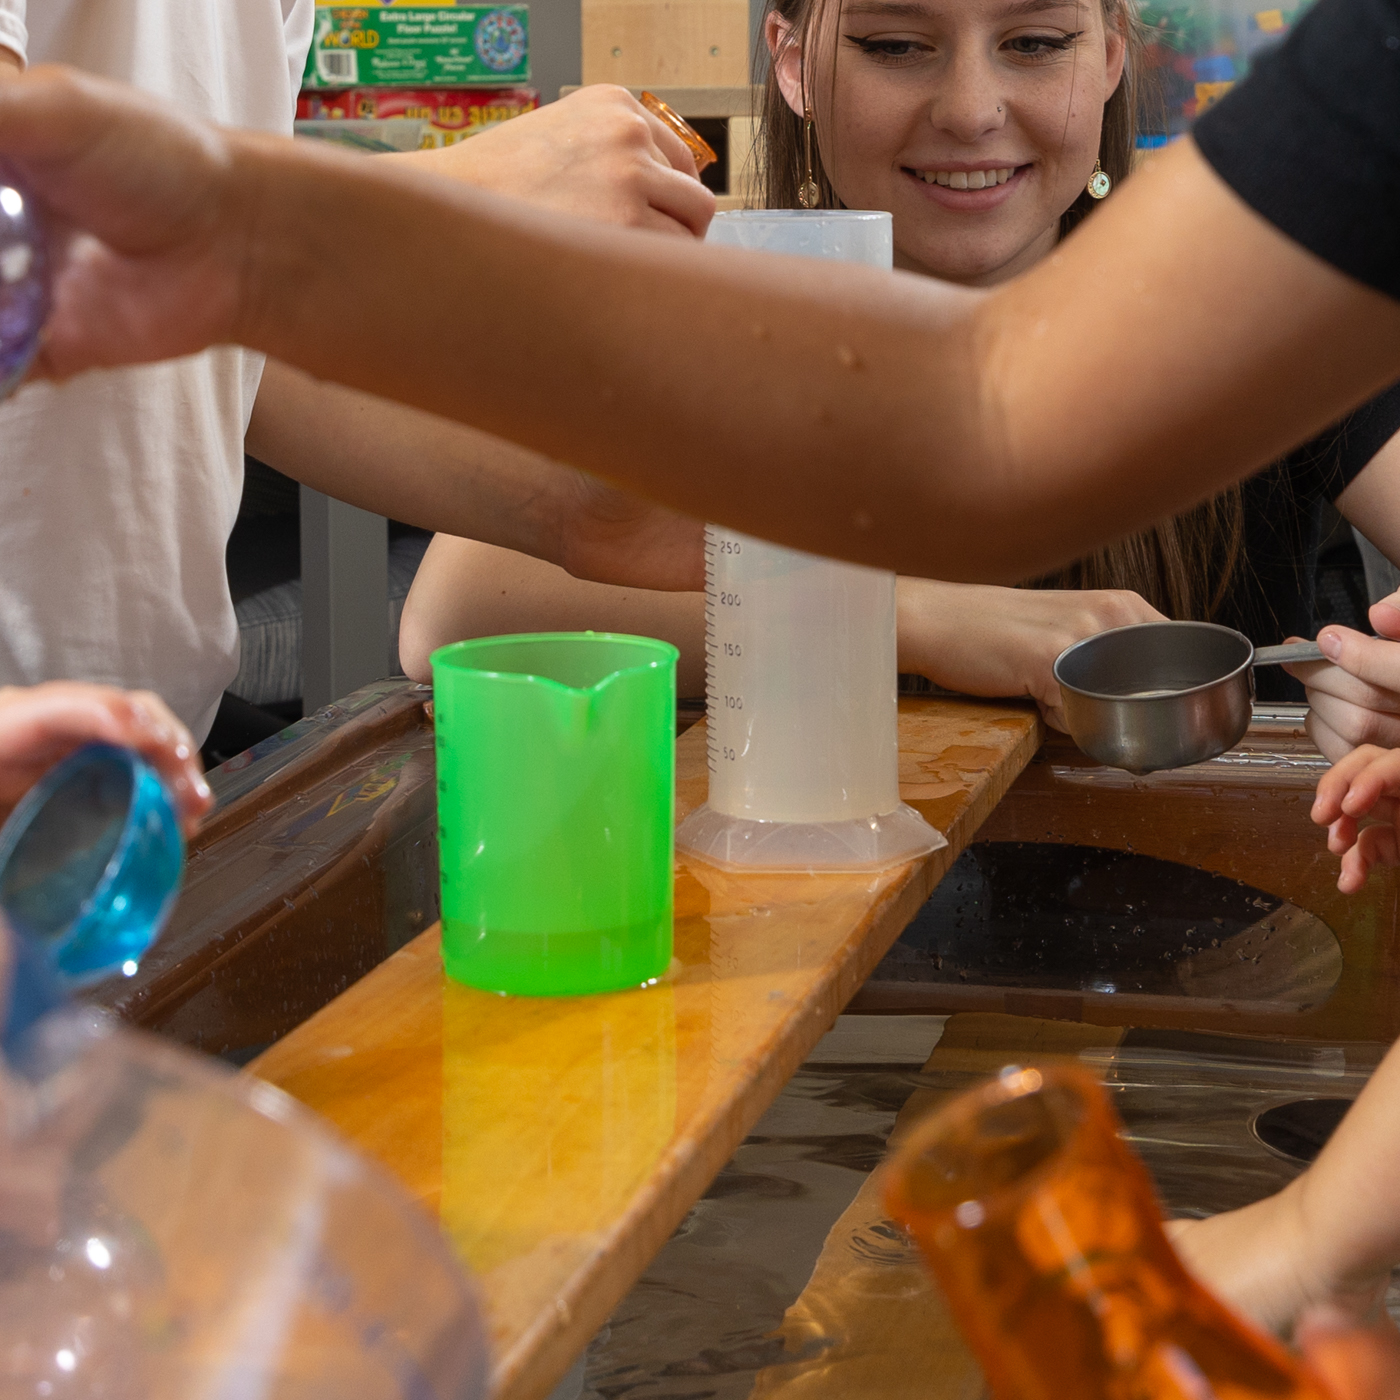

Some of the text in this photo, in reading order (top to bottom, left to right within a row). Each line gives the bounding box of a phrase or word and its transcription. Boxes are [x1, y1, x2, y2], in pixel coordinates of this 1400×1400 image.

[379, 10, 406, 22] Extra
[408, 10, 436, 24] Large
[438, 10, 476, 22] Circular
[720, 540, 741, 555] 250
[720, 591, 742, 607] 200
[724, 642, 742, 658] 150
[724, 695, 743, 710] 100
[723, 746, 736, 762] 50
